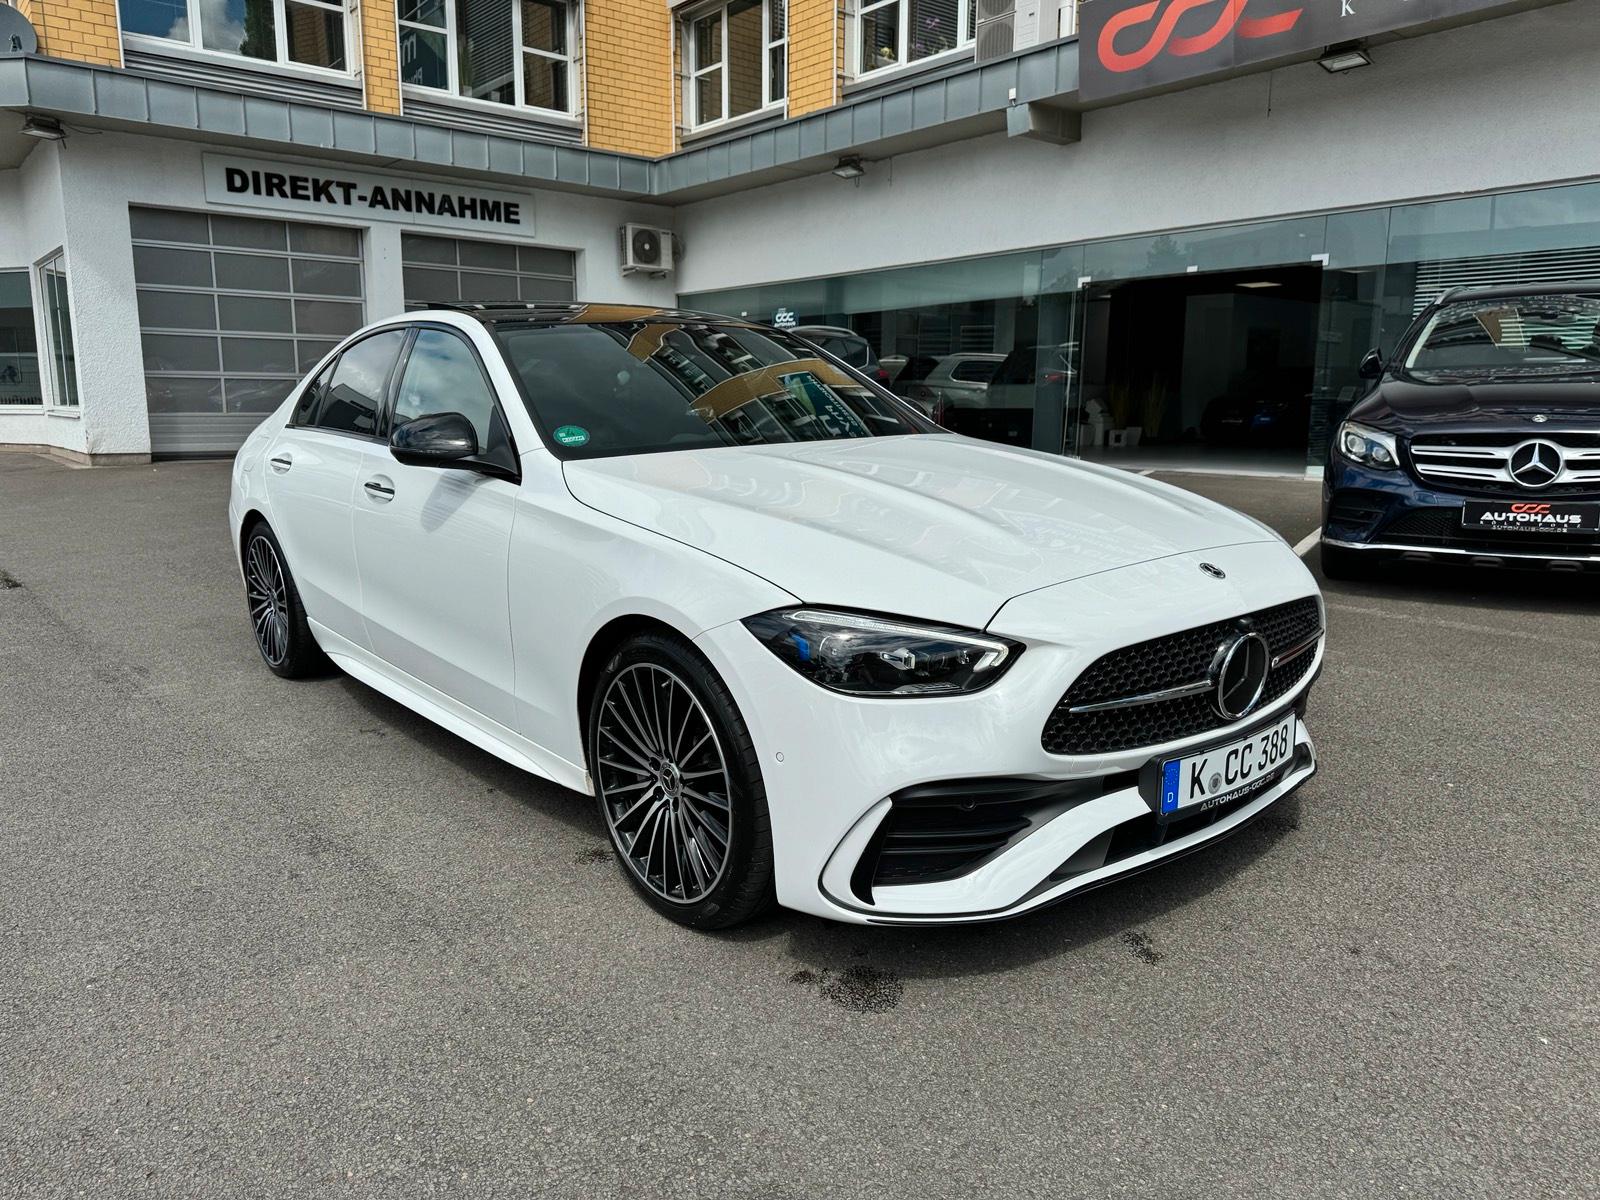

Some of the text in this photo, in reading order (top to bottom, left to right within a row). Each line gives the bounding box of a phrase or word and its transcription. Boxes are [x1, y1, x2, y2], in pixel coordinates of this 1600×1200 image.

[224, 167, 521, 225] DIREKT-ANNAHME
[1480, 511, 1582, 524] AUTOHAUS
[1190, 724, 1288, 799] K CC 388
[1167, 792, 1174, 803] D
